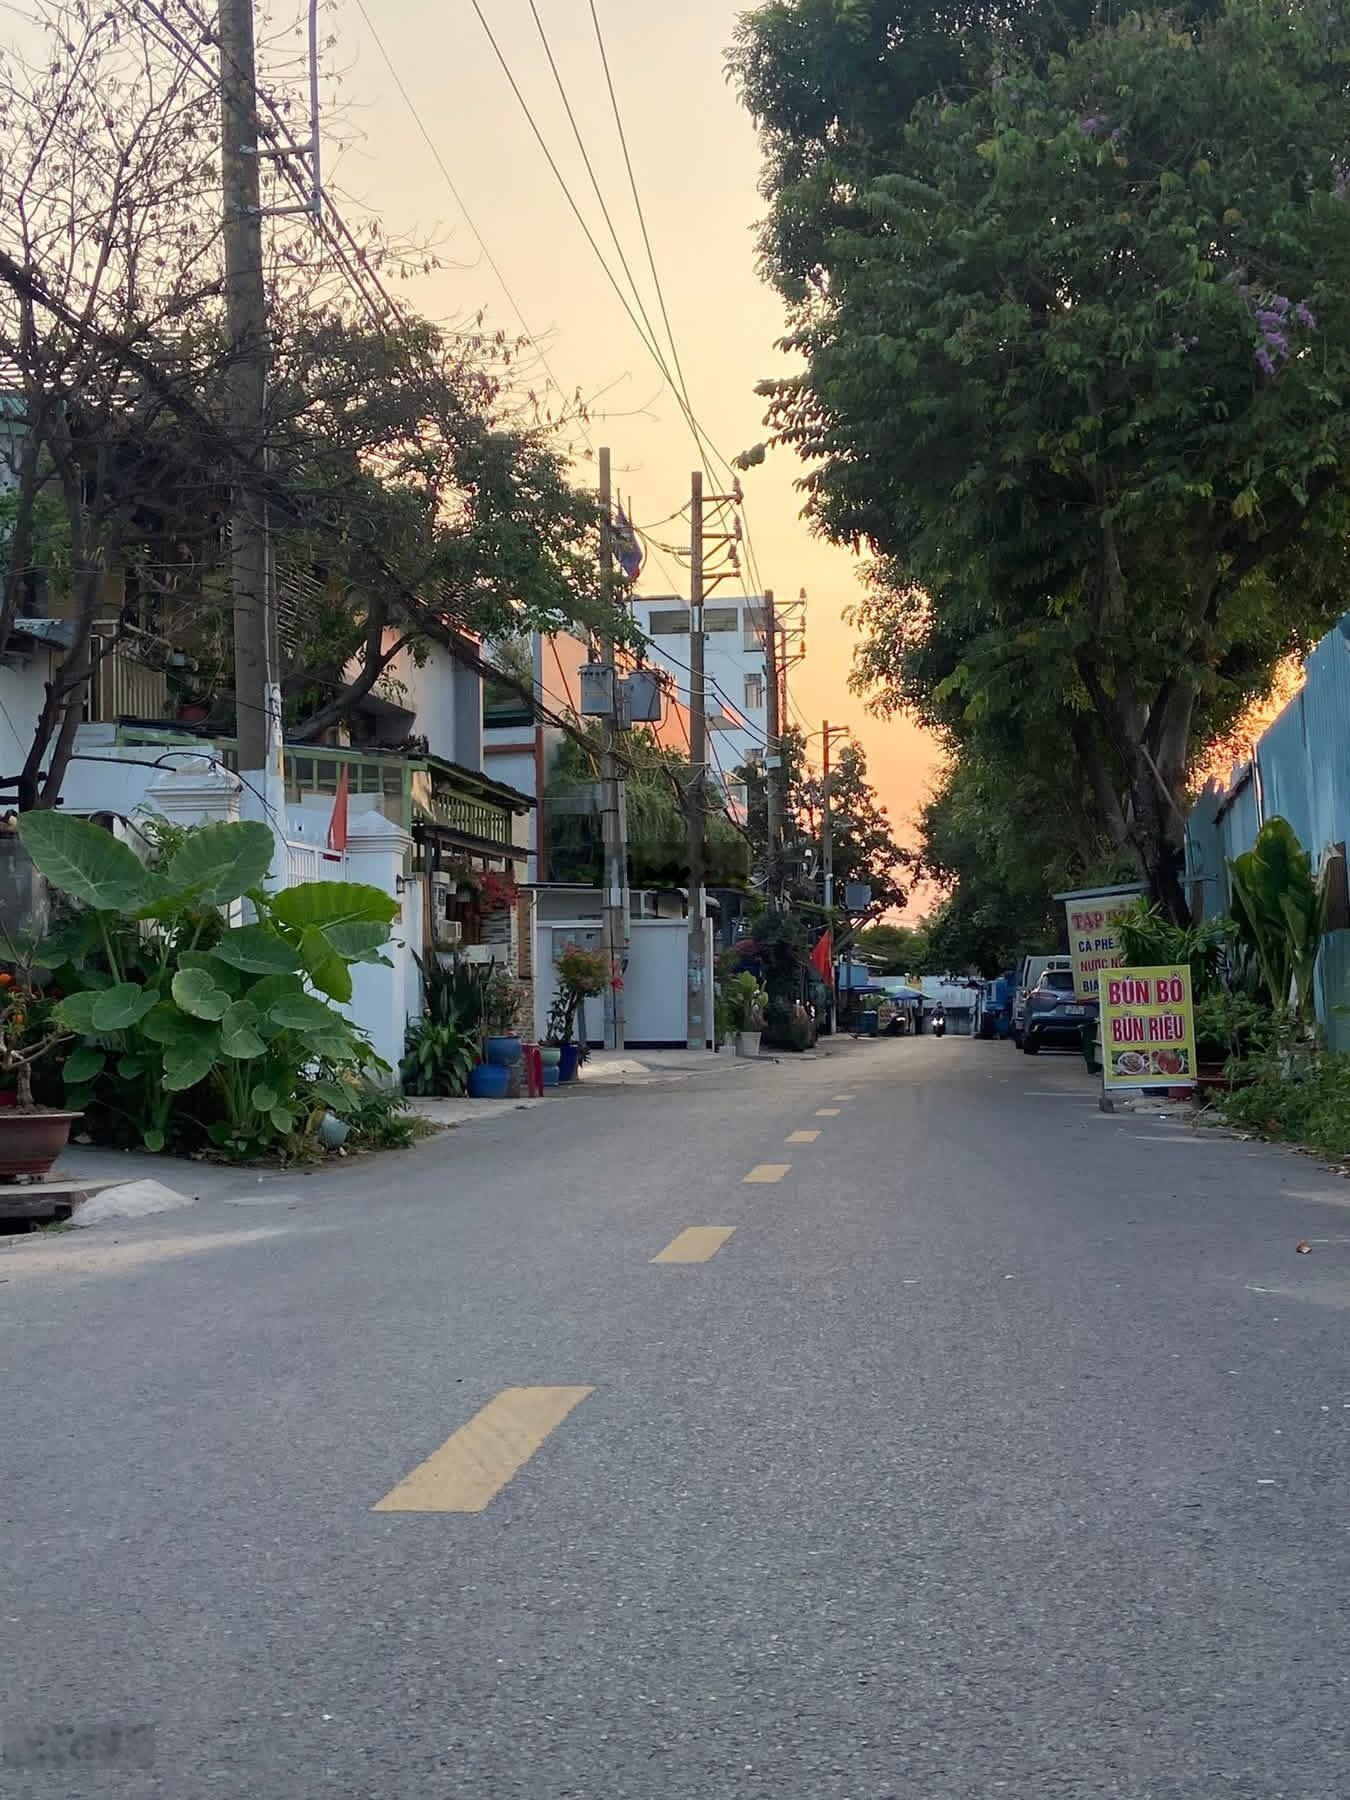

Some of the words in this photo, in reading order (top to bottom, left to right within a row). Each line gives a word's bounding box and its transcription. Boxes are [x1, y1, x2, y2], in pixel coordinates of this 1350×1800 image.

[1108, 975, 1150, 1005] BÚN
[1156, 973, 1184, 1004] BÒ
[1112, 1012, 1144, 1042] BÚN
[1148, 1010, 1184, 1041] RIÊU
